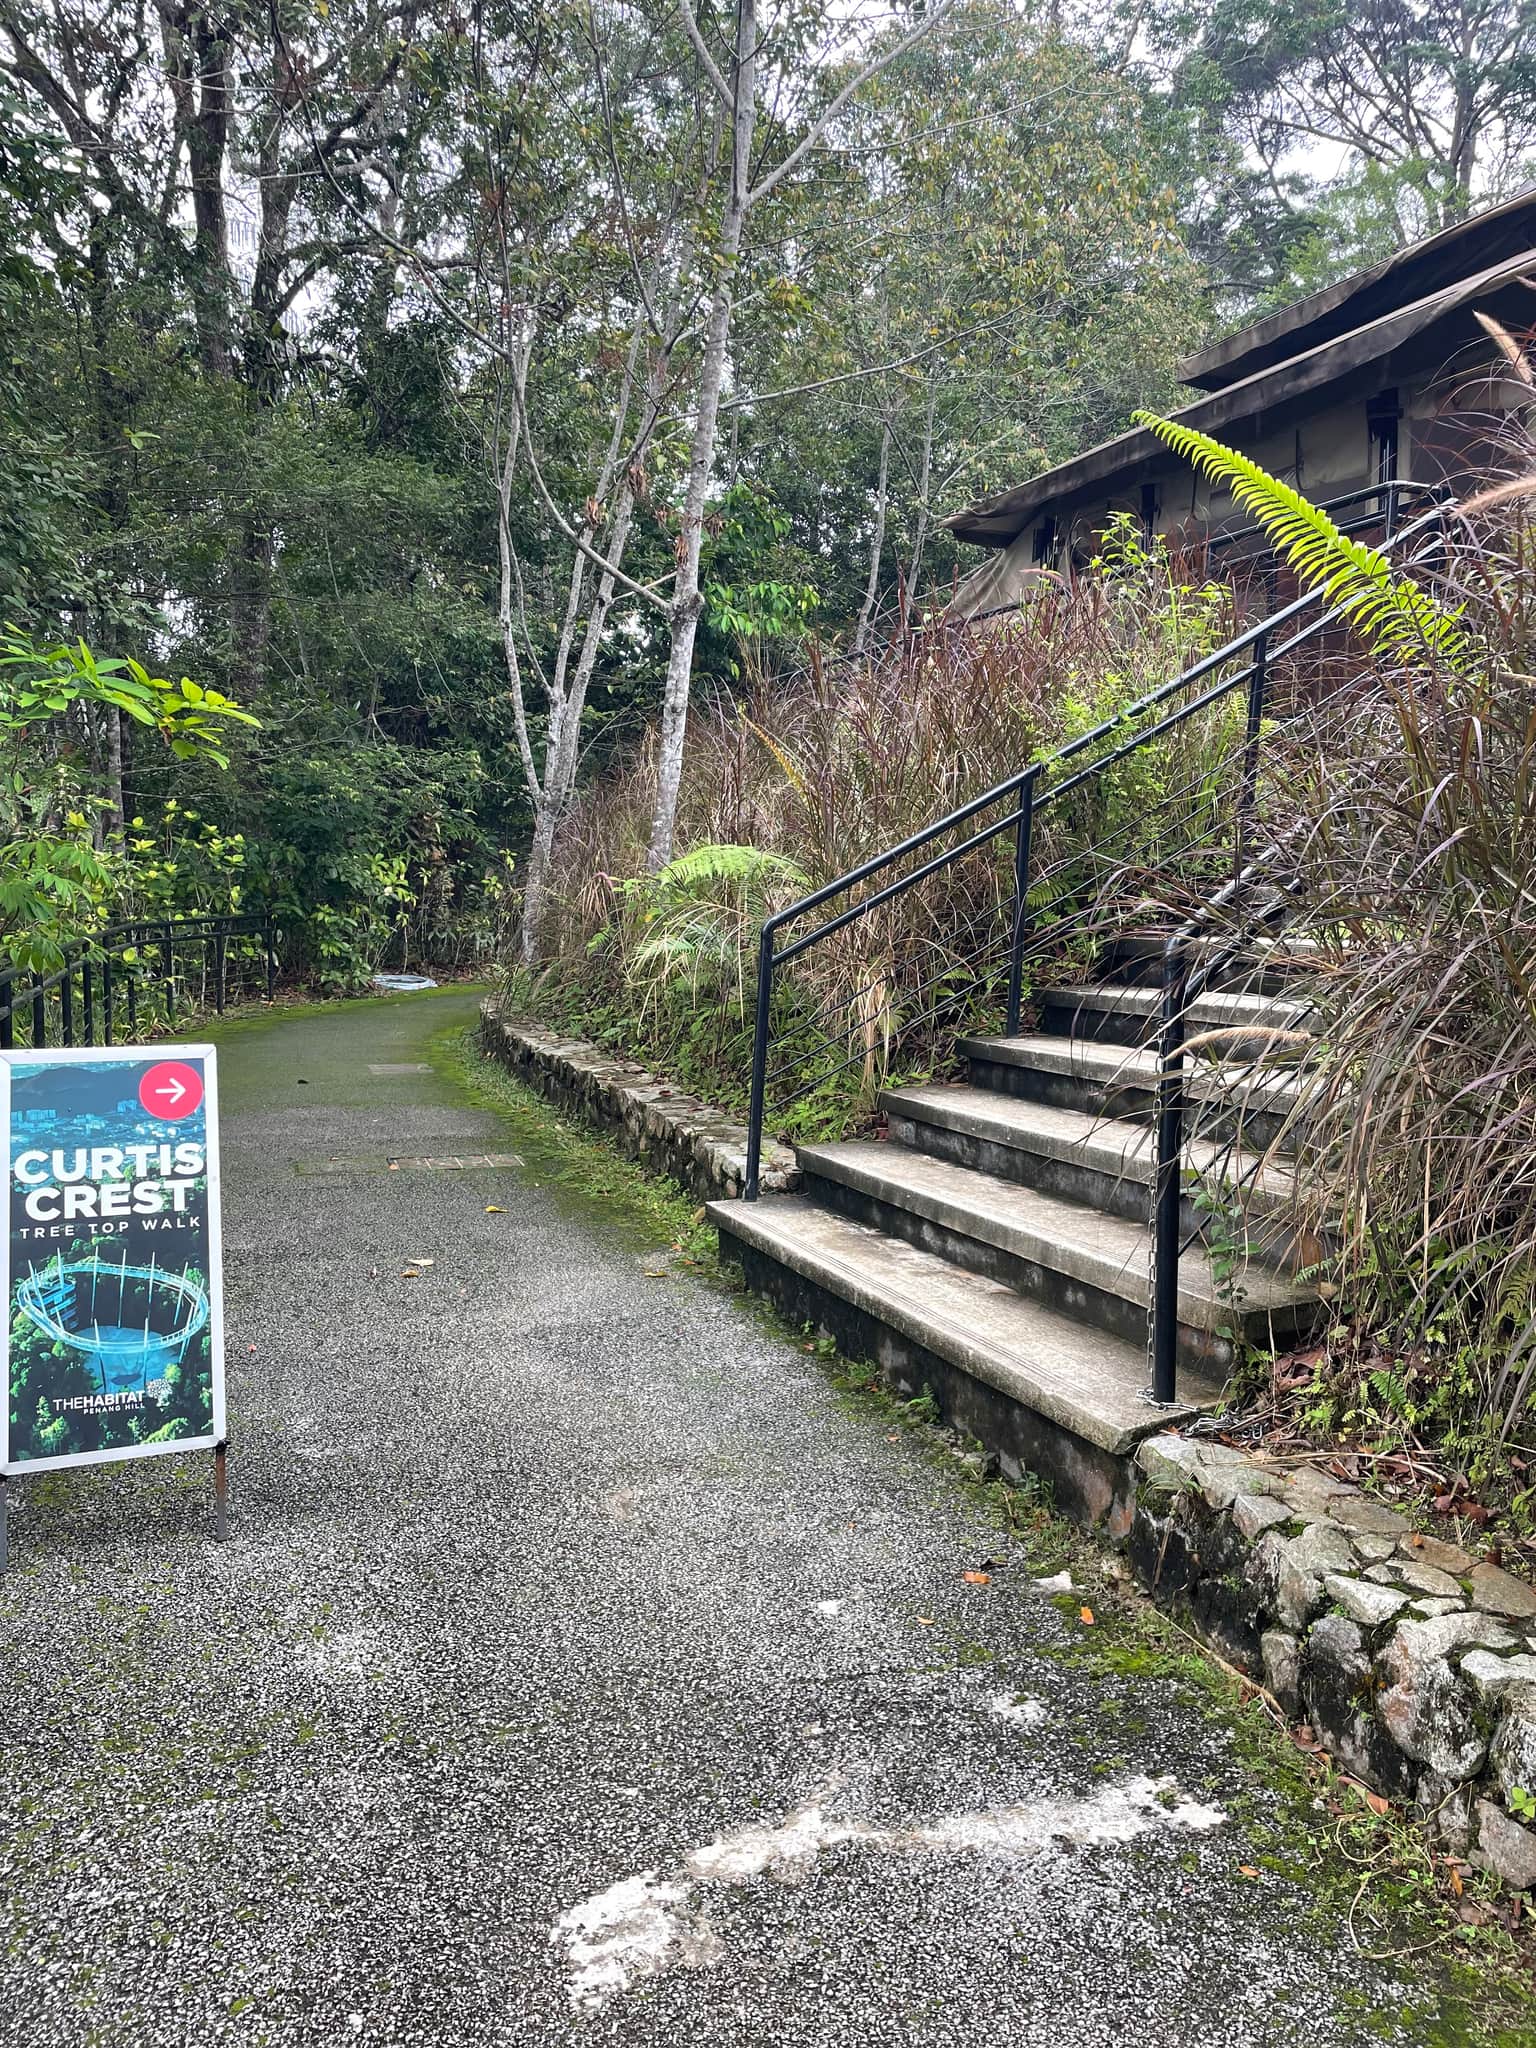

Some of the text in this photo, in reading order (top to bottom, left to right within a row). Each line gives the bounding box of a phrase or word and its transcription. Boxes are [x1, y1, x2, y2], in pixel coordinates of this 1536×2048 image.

[14, 1142, 204, 1184] CURTIS
[25, 1178, 194, 1221] CREST
[20, 1216, 200, 1239] TREE TOP WALK
[83, 1403, 145, 1415] PENANG HILL
